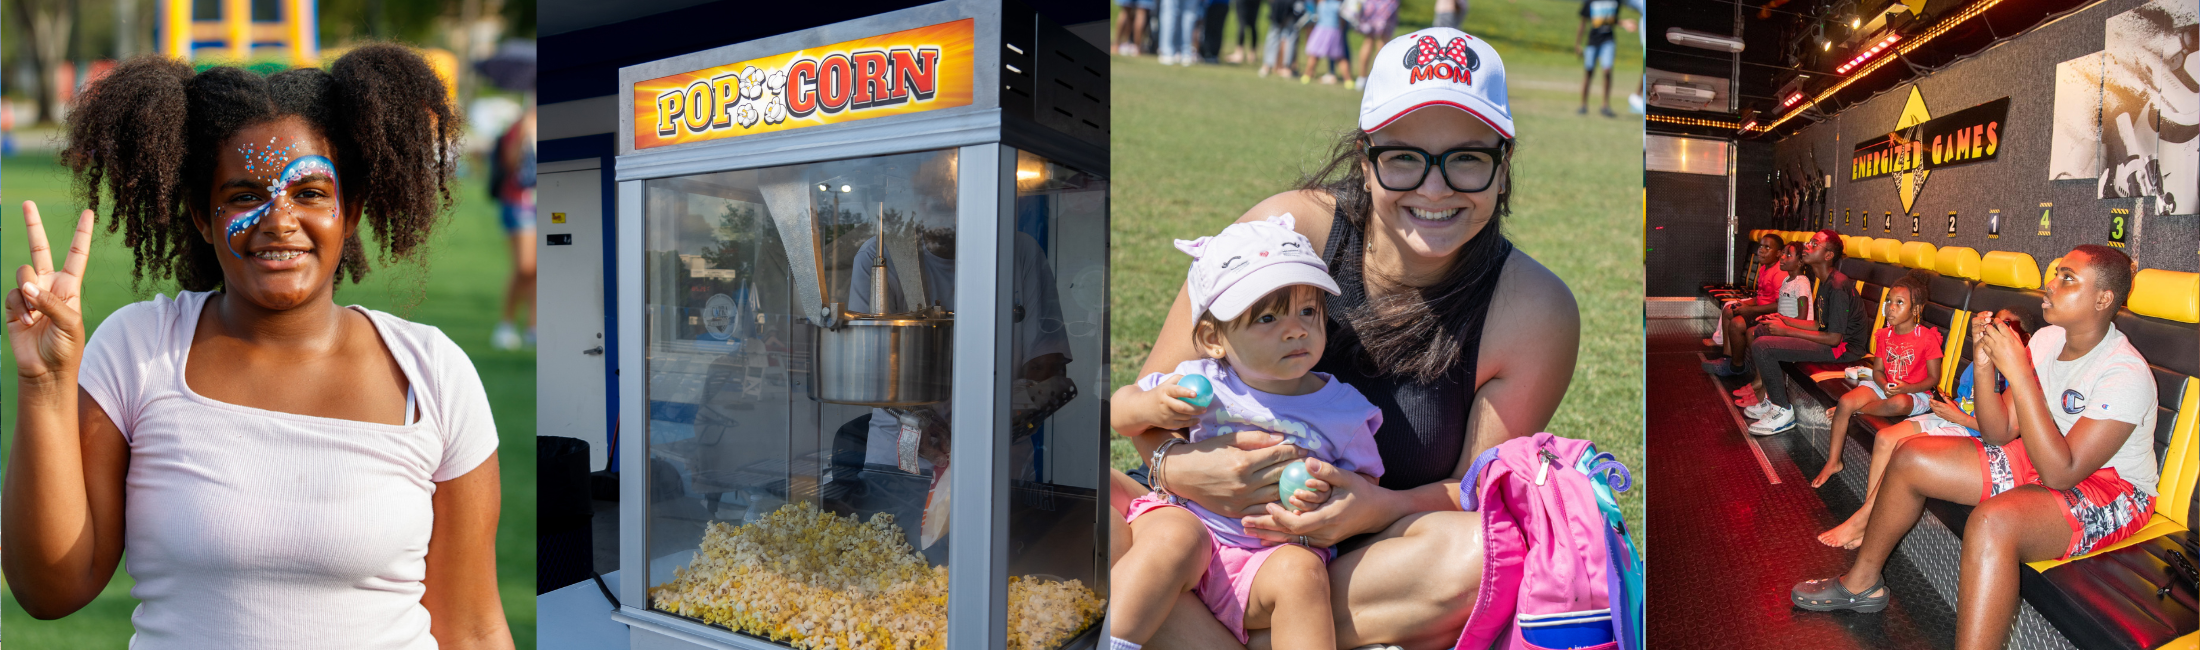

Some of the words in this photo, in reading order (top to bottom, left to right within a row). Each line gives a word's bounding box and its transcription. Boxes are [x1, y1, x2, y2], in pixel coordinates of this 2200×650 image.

[1410, 62, 1472, 86] MOM
[659, 74, 740, 135] POP
[785, 49, 939, 117] CORN
[1851, 140, 1922, 181] ENERGIZED
[1931, 121, 1998, 165] GAMES
[1885, 215, 1891, 229] 4
[1913, 217, 1919, 232] 3
[1949, 216, 1956, 232] 2
[1990, 216, 1998, 233] 1
[2040, 209, 2050, 229] 4
[2111, 216, 2124, 240] 3
